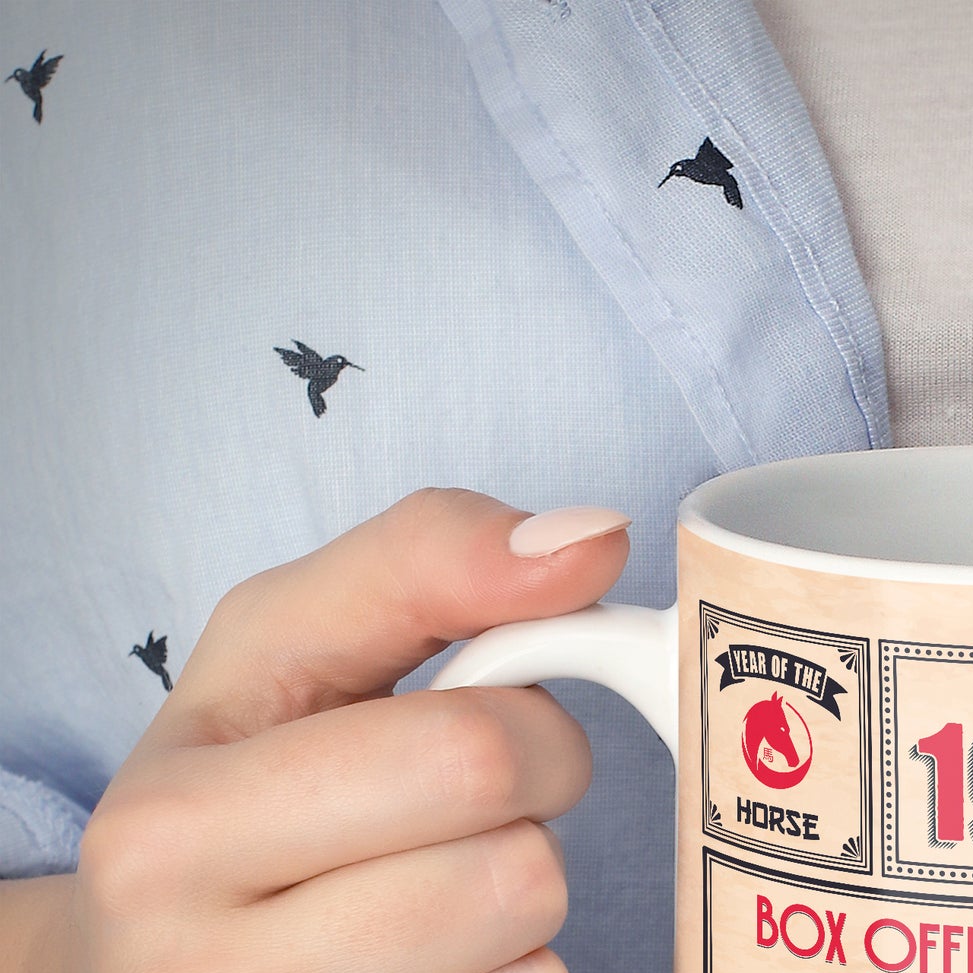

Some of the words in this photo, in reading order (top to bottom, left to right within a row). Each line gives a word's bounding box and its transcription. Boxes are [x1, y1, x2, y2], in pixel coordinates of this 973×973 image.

[733, 649, 768, 677] YEAR
[770, 655, 788, 680] OF
[791, 660, 824, 694] THE
[736, 796, 821, 841] HORSE
[756, 894, 848, 966] BOX
